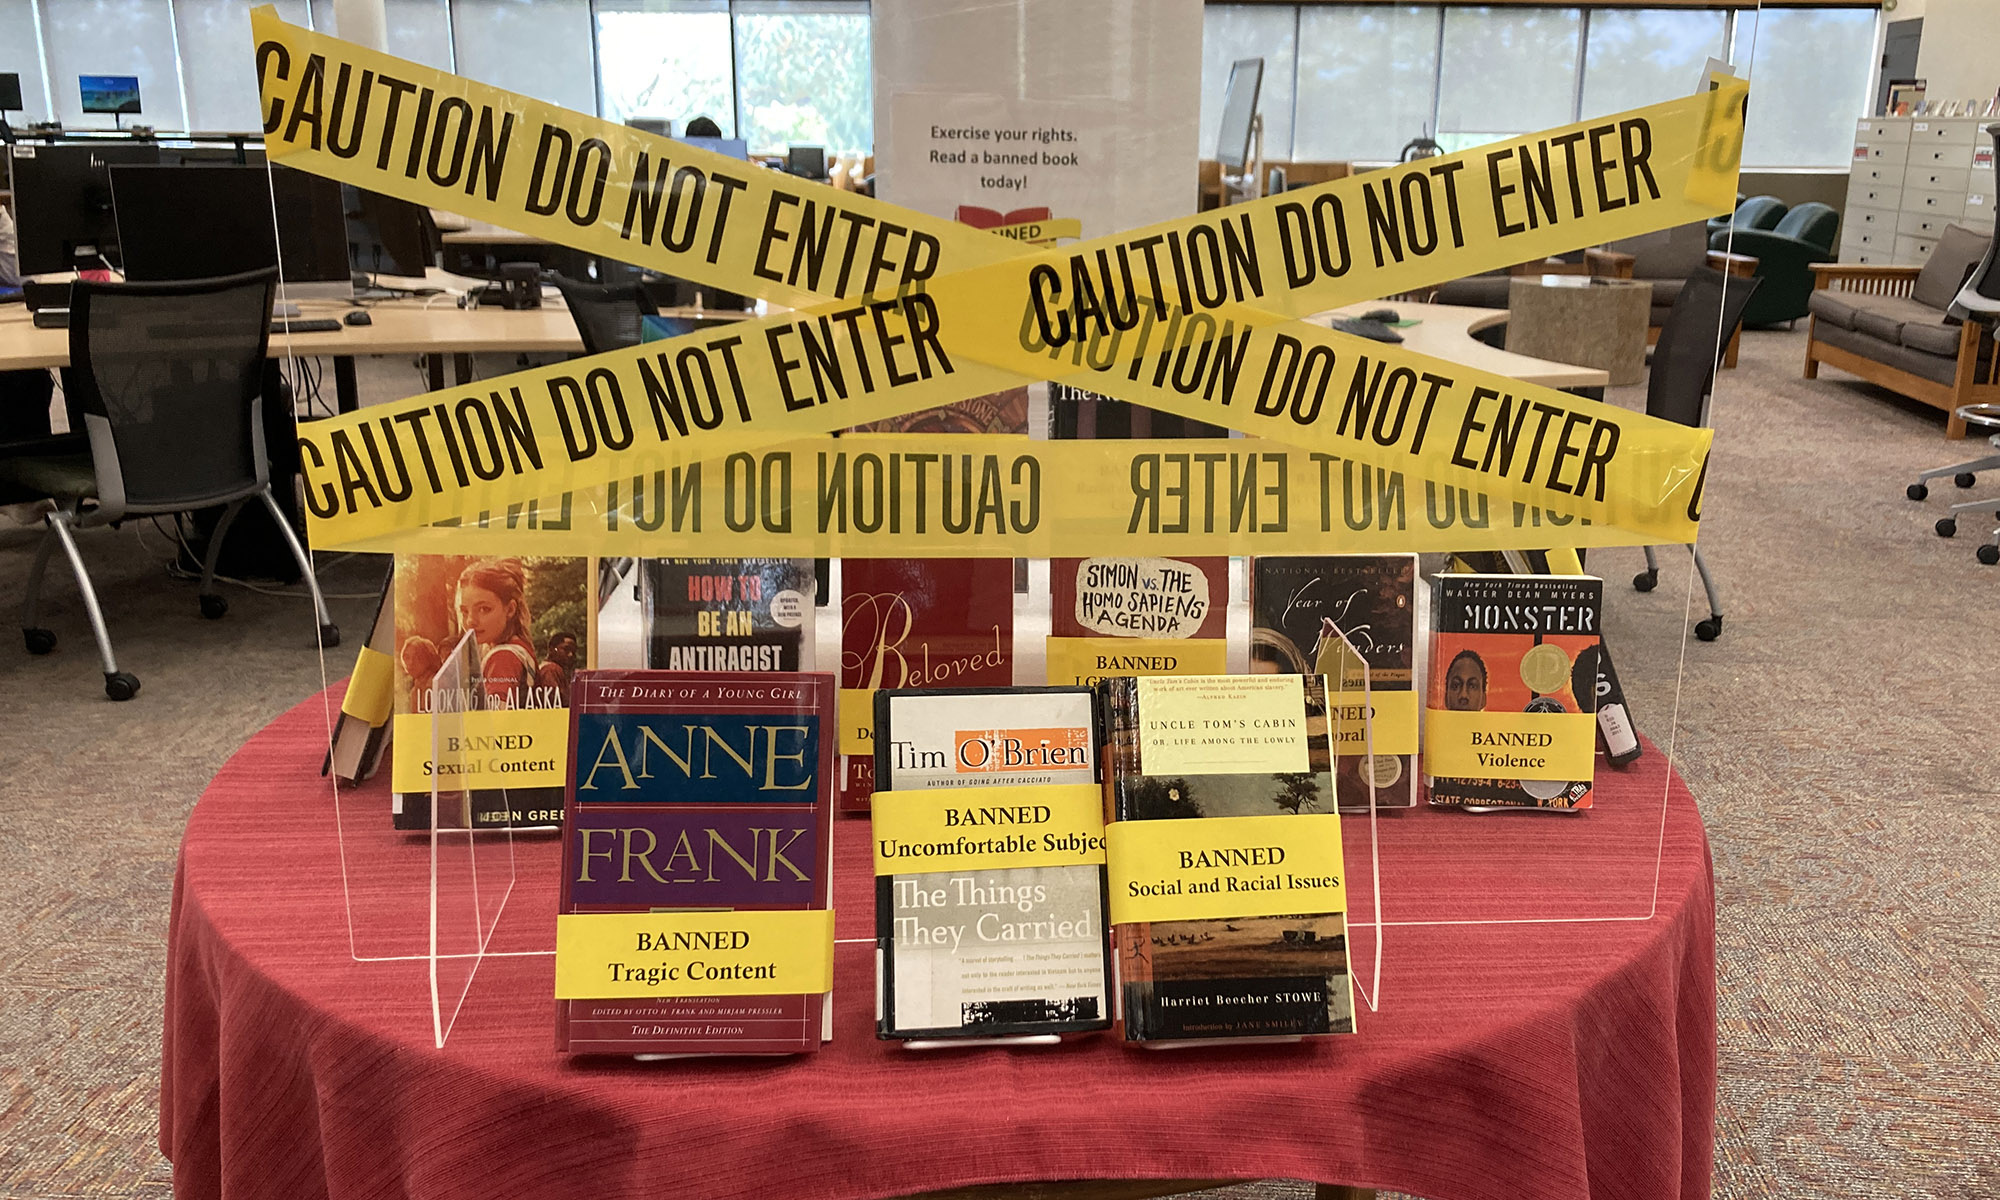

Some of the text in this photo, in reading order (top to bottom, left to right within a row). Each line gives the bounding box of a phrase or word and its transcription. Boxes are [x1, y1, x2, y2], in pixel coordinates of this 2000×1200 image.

[931, 125, 1078, 144] Exercise your rights.
[929, 150, 1079, 166] Read a banned book
[256, 41, 941, 321] CAUTION DO NOT ENTER
[980, 175, 1027, 191] today!
[1029, 213, 1262, 349] CAUTION
[1278, 193, 1352, 289] DO
[1363, 159, 1465, 268] NOT
[1487, 117, 1661, 239] ENTER
[300, 386, 543, 519] CAUTION
[547, 367, 634, 463] DO
[637, 336, 753, 442] NOT
[764, 293, 955, 413] ENTER
[1254, 337, 1336, 428] DO
[1336, 355, 1452, 457] NOT
[1452, 387, 1622, 503] ENTER
[688, 575, 762, 602] HOW TO
[1087, 564, 1139, 591] SIMON
[1159, 569, 1192, 593] THE
[1083, 592, 1205, 620] HOMO SAPIENS
[1281, 577, 1323, 629] Year
[1446, 589, 1595, 600] WALTER DEAN MYERS
[698, 610, 753, 637] BE AN
[1096, 611, 1180, 633] AGENDA
[1464, 604, 1594, 632] MONSTER
[841, 591, 1005, 690] Beloved
[669, 645, 783, 671] ANTIRACIST
[1096, 655, 1177, 671] BANNED
[505, 686, 563, 710] ALASKA
[599, 685, 626, 699] THE
[631, 686, 675, 699] DIARY
[718, 686, 765, 700] YOUNG
[771, 687, 802, 700] GIRL
[1150, 718, 1296, 730] UNCLE TOM'S CABIN
[448, 735, 533, 752] BANNED
[1152, 739, 1169, 747] OR,
[1174, 738, 1196, 746] LIFE
[1201, 737, 1236, 745] AMONG
[1471, 732, 1553, 747] BANNED
[580, 724, 812, 791] ANNE
[890, 737, 1089, 771] Tim O'Brien
[1476, 753, 1546, 768] Violence
[423, 758, 556, 776] Sexual Content
[944, 805, 1051, 827] BANNED
[576, 828, 811, 884] FRANK
[878, 836, 1037, 858] Uncomfortable
[1178, 846, 1286, 870] BANNED
[893, 877, 1047, 914] The Things
[1128, 873, 1340, 898] Social and Racial Issues
[636, 931, 750, 952] BANNED
[894, 910, 1093, 954] They Carried
[608, 960, 777, 986] Tragic Content
[747, 1007, 783, 1015] PRESSLER
[1160, 992, 1322, 1007] Harriet Beecher STOWE
[631, 1025, 745, 1035] THE DEFINITIVE EDITION
